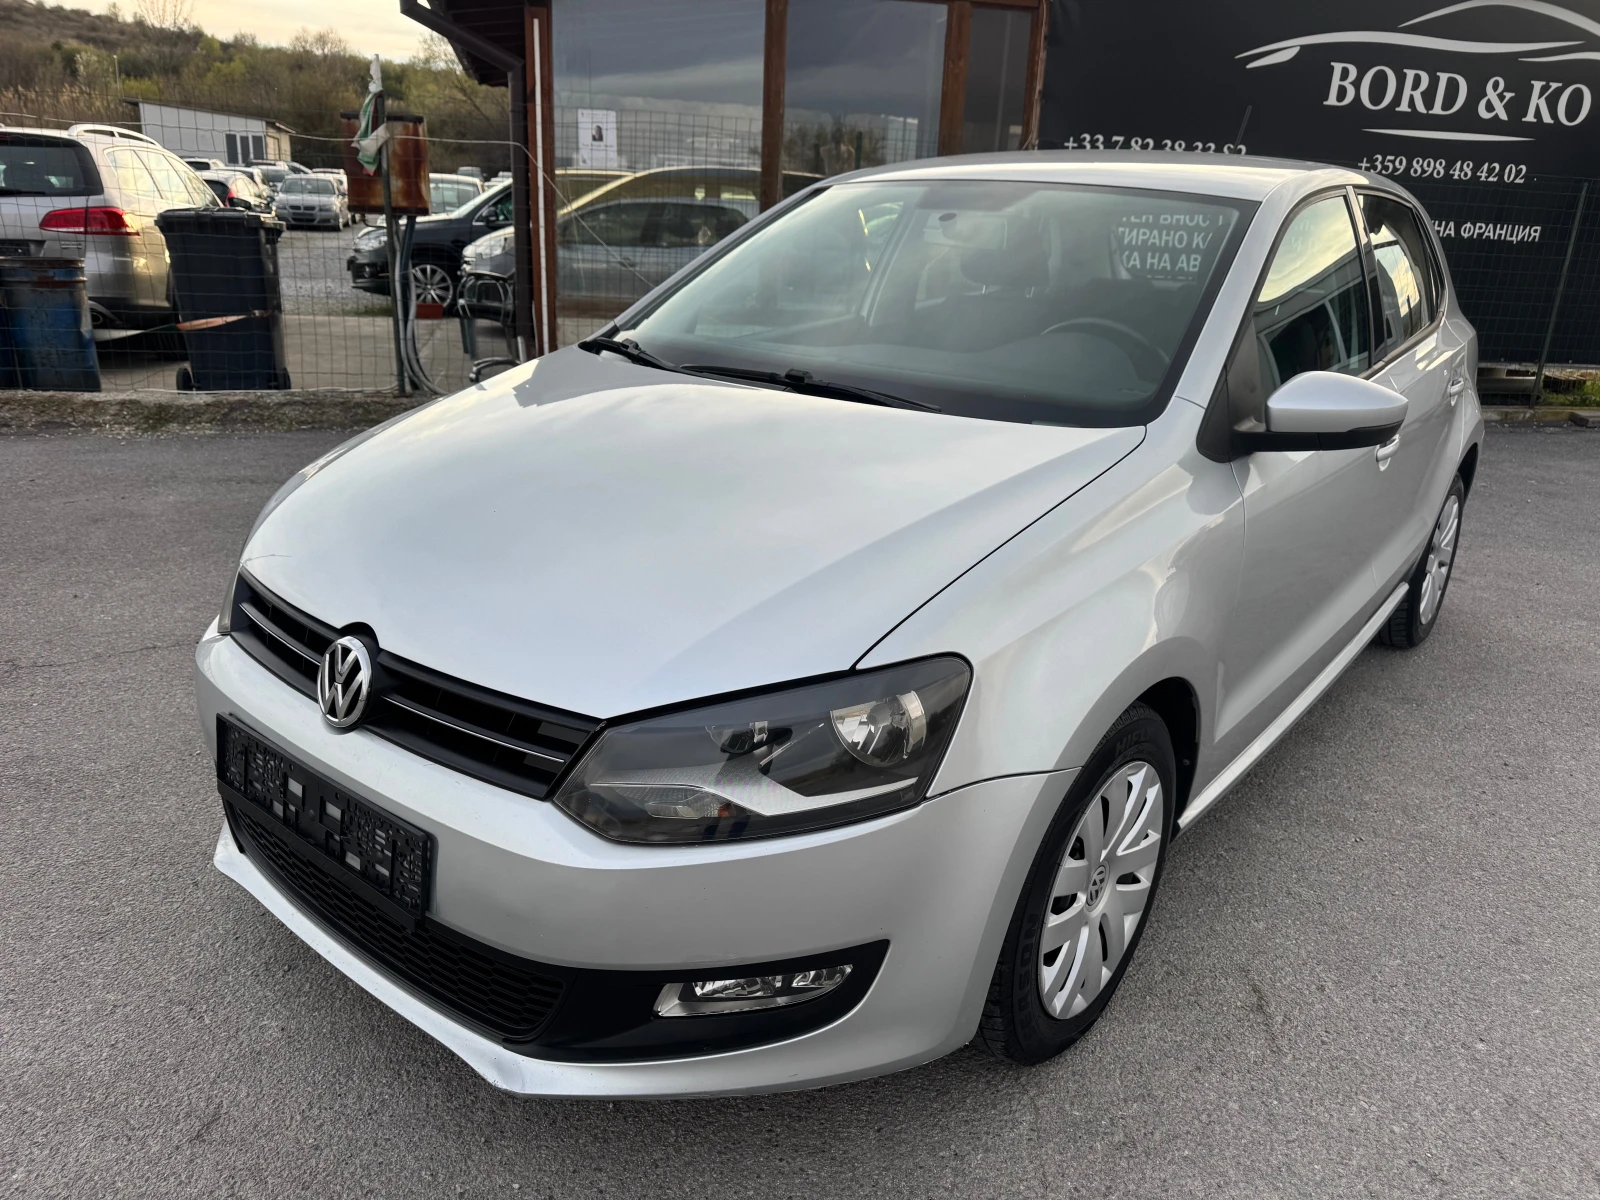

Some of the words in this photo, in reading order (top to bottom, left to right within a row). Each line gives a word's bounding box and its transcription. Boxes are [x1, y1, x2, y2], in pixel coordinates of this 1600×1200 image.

[1323, 61, 1468, 116] BORD
[1477, 76, 1516, 121] &
[1521, 80, 1593, 126] KO
[1358, 153, 1407, 176] +359
[1410, 157, 1446, 179] 898
[1449, 160, 1473, 181] 48
[1476, 162, 1500, 182] 42
[1503, 163, 1527, 184] 02
[1460, 221, 1542, 244] ФРАНЦИЯ
[1146, 251, 1171, 271] НА
[318, 637, 371, 727] VW
